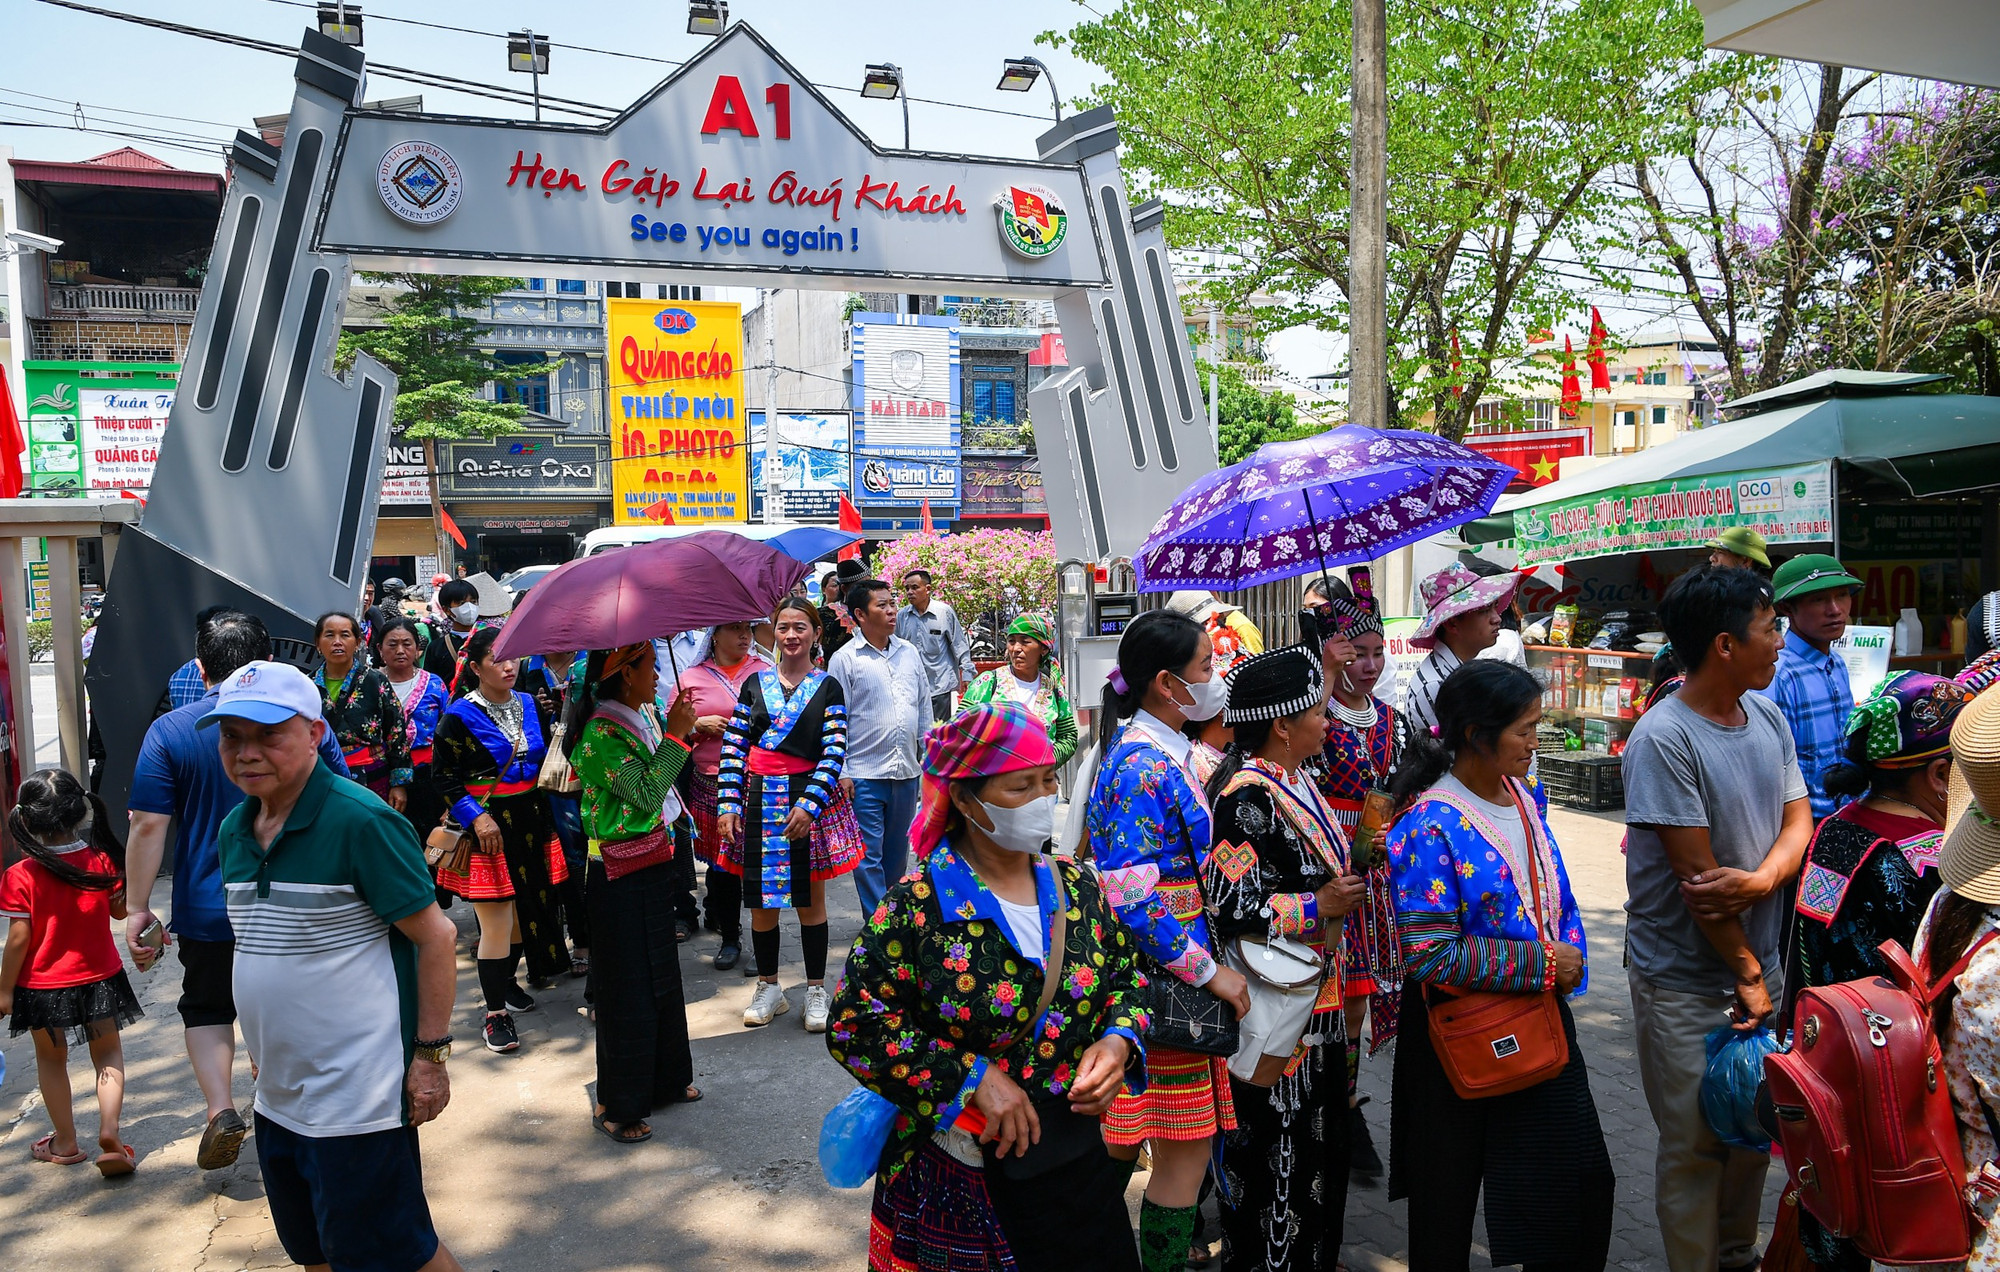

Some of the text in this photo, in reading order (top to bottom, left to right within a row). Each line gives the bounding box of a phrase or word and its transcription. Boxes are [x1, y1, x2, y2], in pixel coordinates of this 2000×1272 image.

[701, 75, 790, 140] A1
[507, 151, 966, 221] Hẹn Gặp Lại Quý Khách
[398, 206, 423, 219] BIEN
[424, 190, 458, 219] TOURISM
[631, 214, 687, 242] See
[697, 226, 750, 251] you
[762, 225, 843, 255] again
[662, 314, 688, 329] DK
[104, 394, 148, 409] Xuân
[621, 389, 734, 419] THIẾP MỜI
[94, 415, 125, 432] Thiệp
[95, 445, 139, 464] QUẢNG
[1550, 479, 1735, 537] TRÀ SẠCH HỮU CƠ ĐẠT CHUẨN QUỐC GIA
[505, 520, 515, 529] TY
[1102, 621, 1117, 632] SAFE
[1390, 632, 1403, 655] BỐ
[1853, 633, 1886, 648] NHẤT
